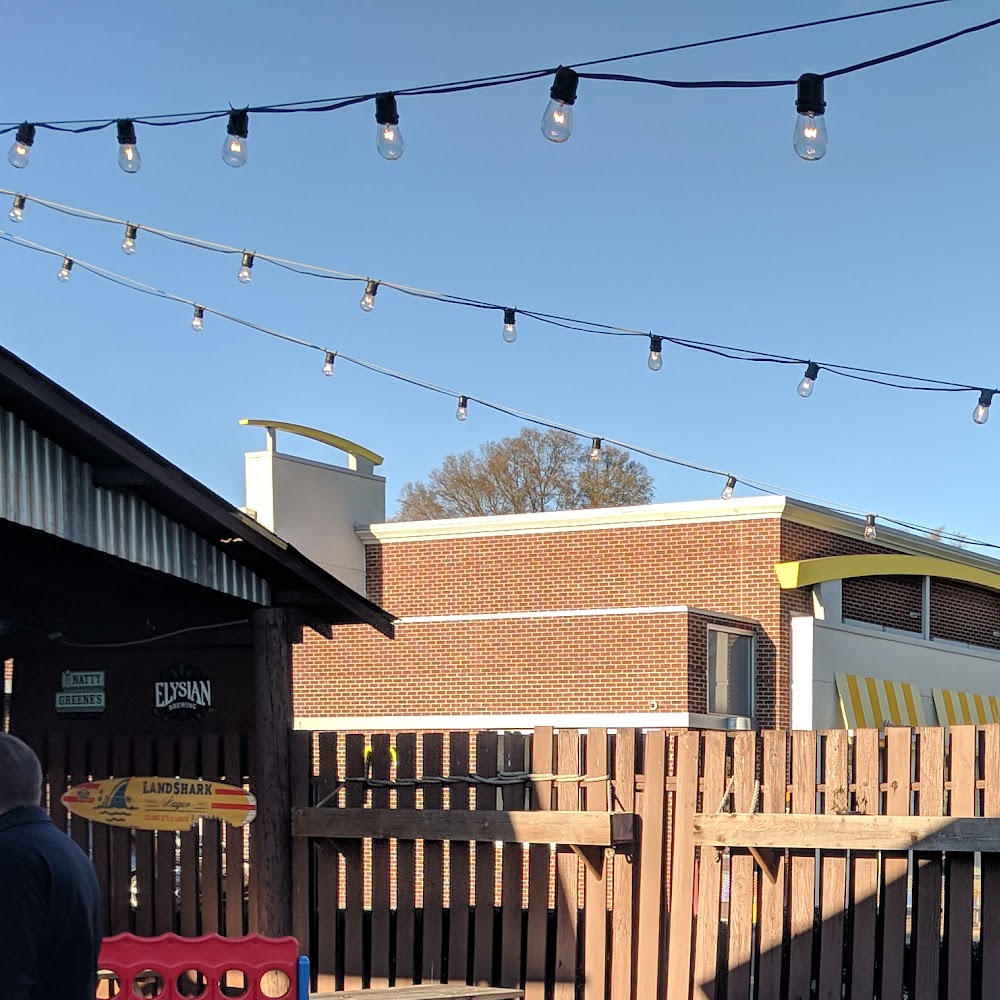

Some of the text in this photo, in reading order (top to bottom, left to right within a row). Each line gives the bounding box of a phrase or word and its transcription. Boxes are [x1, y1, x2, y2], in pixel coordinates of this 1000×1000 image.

[72, 674, 101, 685] NATTY
[155, 680, 212, 708] ELYSIAN
[168, 702, 197, 711] BREWING
[142, 781, 212, 796] LANDSHARK
[162, 795, 191, 811] Lager
